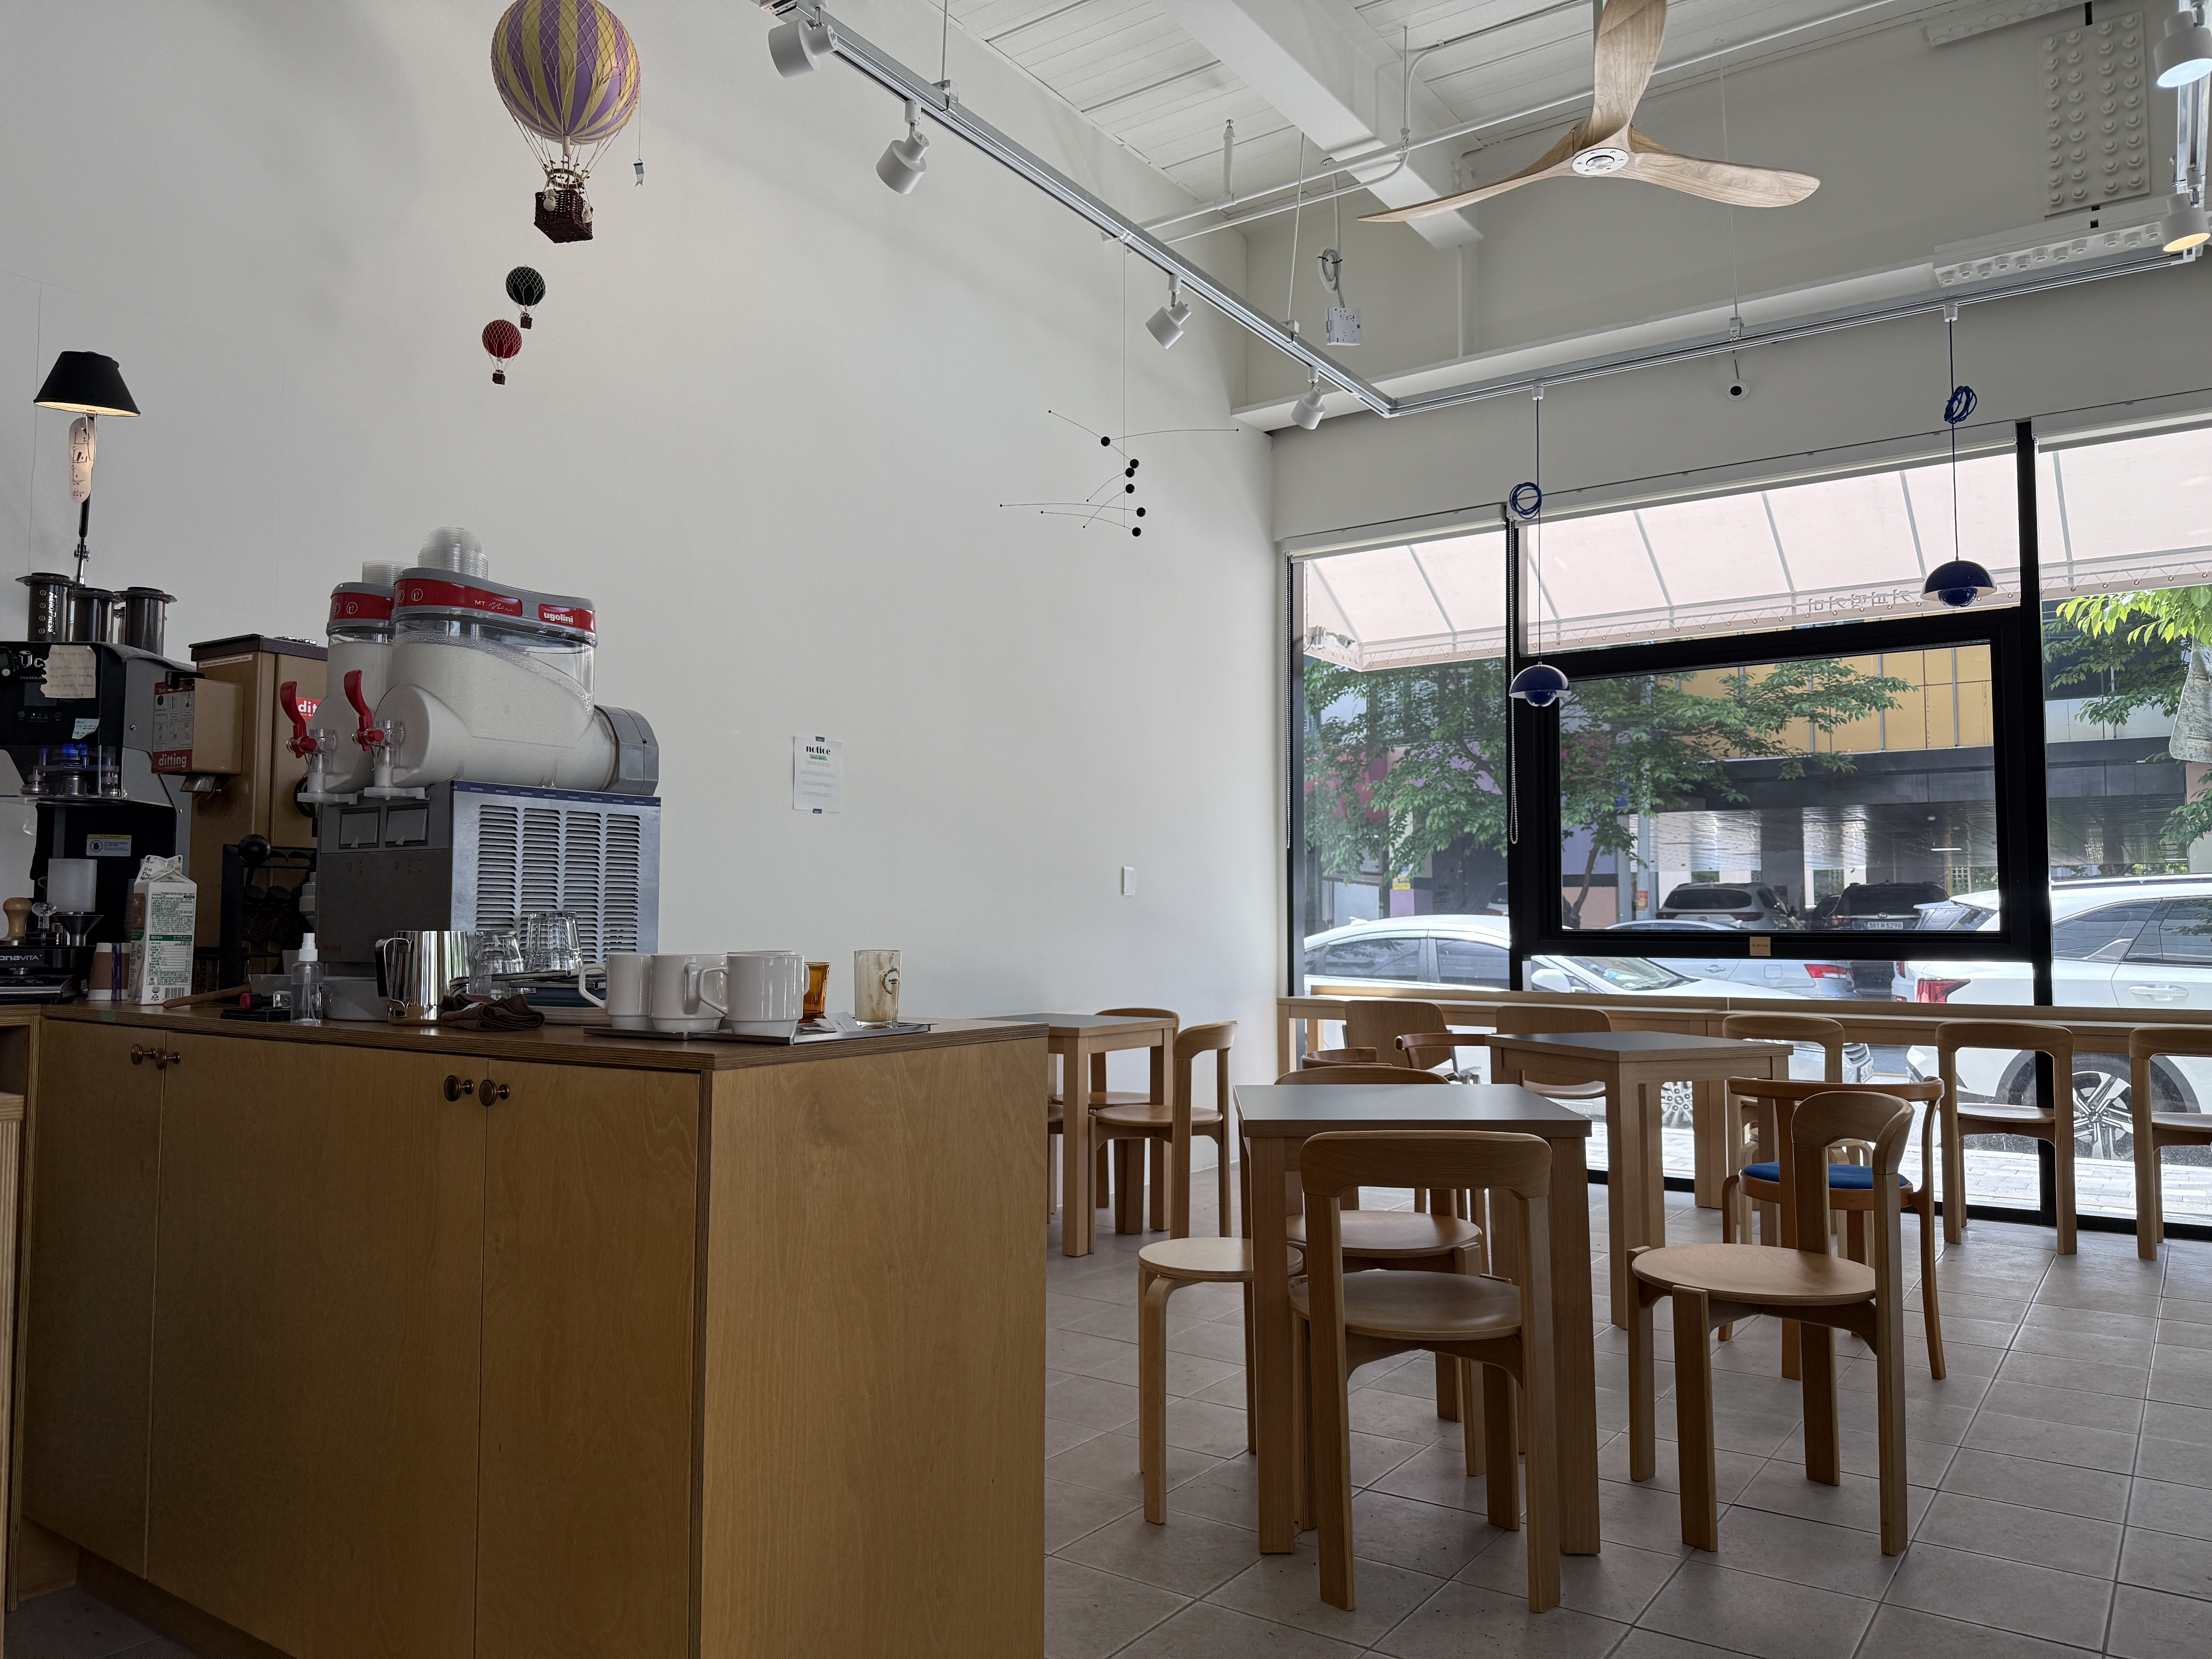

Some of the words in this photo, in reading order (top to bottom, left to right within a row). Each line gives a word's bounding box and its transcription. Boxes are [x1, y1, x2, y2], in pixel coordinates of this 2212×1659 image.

[543, 612, 574, 623] ugolini
[805, 745, 831, 755] notice
[158, 753, 187, 768] ditting
